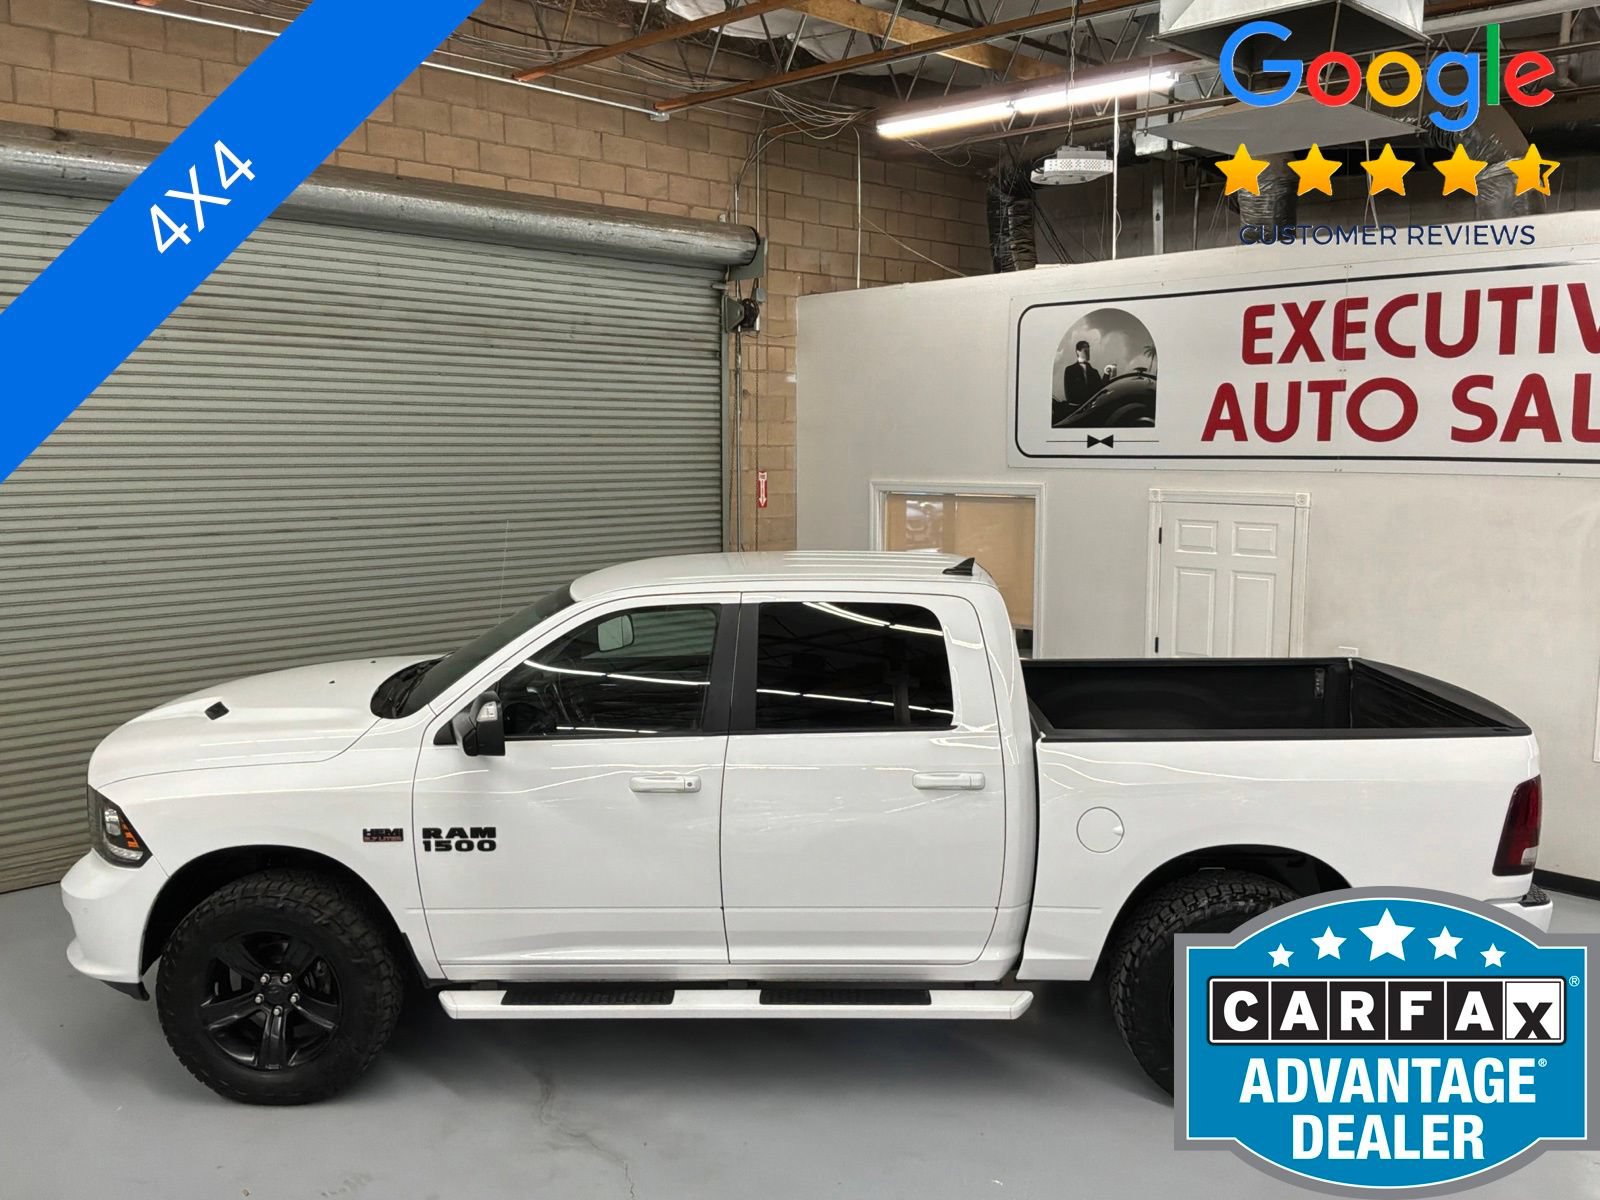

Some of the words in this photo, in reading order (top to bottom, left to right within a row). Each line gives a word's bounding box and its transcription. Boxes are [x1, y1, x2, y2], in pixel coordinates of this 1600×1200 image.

[1200, 376, 1419, 443] AUTO
[422, 827, 496, 839] RAM
[423, 840, 497, 852] 1500
